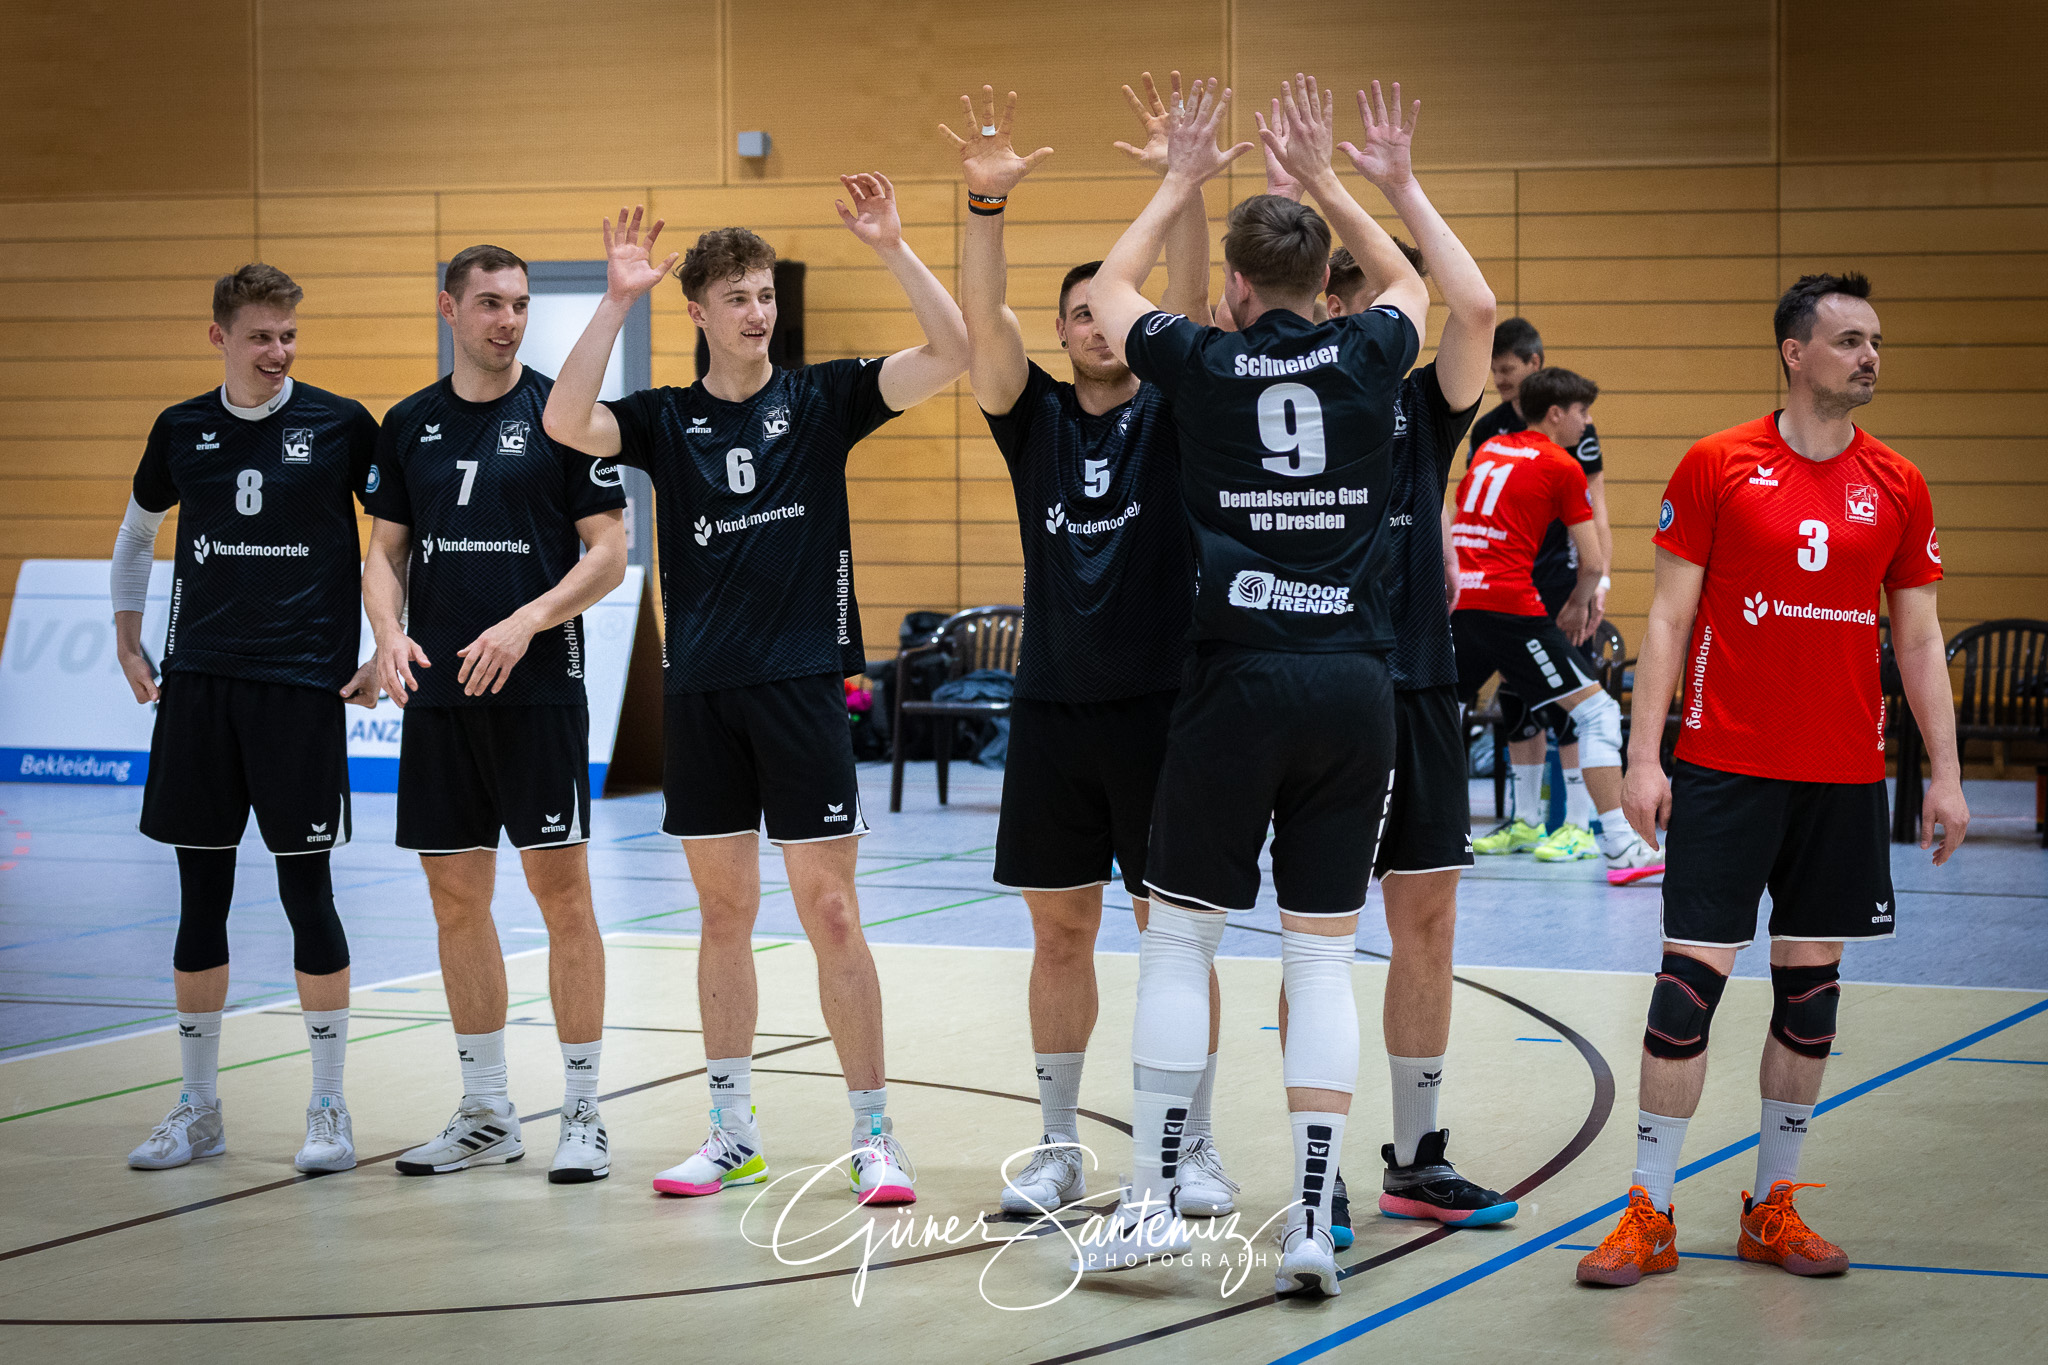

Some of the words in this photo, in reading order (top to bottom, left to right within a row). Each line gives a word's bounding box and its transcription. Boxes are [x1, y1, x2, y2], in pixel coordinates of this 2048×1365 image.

[1234, 345, 1340, 377] Schneider
[420, 433, 442, 443] erima
[686, 426, 712, 434] erima
[1257, 382, 1326, 477] 9
[196, 440, 220, 450] erima
[284, 444, 309, 458] VC
[501, 435, 525, 449] VC
[726, 448, 756, 494] 6
[1084, 458, 1110, 498] 5
[456, 460, 479, 506] 7
[1463, 460, 1514, 516] 11
[1749, 477, 1778, 486] erima
[235, 469, 263, 516] 8
[1219, 488, 1336, 508] Dentalservice
[1338, 487, 1369, 505] Gust
[1848, 500, 1875, 517] VC
[1250, 514, 1273, 531] VC
[1276, 512, 1345, 531] Dresden
[213, 541, 309, 557] Vandemoortele
[437, 537, 531, 555] Vandemoortele
[1797, 519, 1829, 572] 3
[1274, 579, 1350, 601] INDOOR
[1773, 599, 1876, 626] Vandemoortele
[564, 618, 583, 679] Feldschlö
[20, 753, 131, 783] Bekleidung
[824, 812, 848, 822] erima
[306, 832, 332, 843] erima
[541, 823, 566, 834] erima
[1871, 914, 1893, 924] erima
[1637, 1133, 1658, 1143] rima
